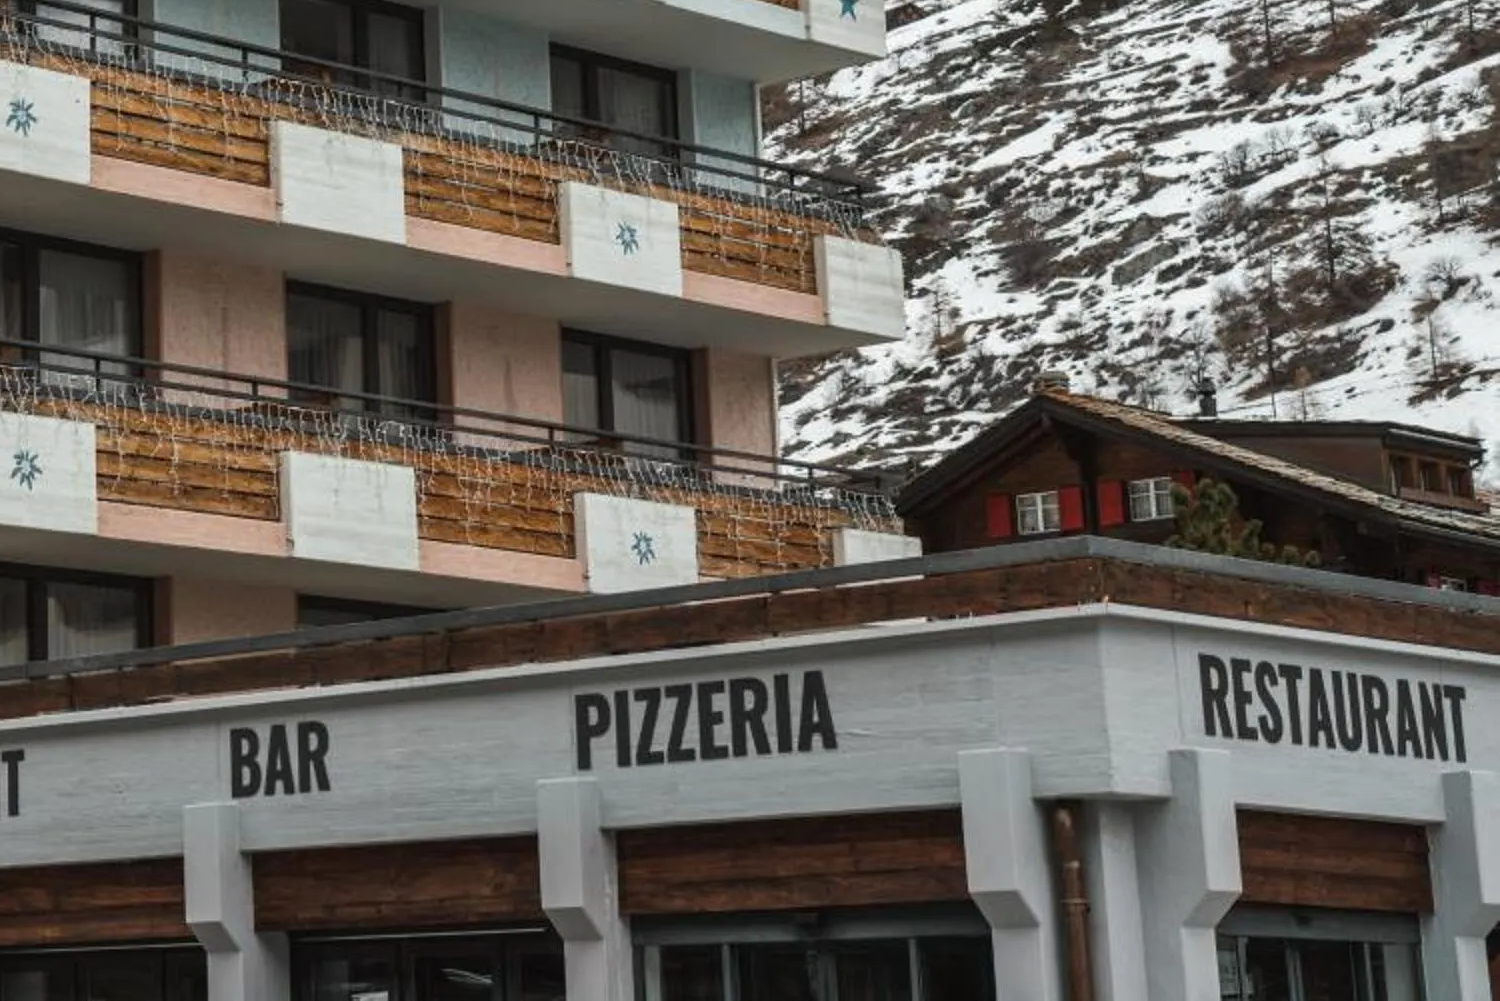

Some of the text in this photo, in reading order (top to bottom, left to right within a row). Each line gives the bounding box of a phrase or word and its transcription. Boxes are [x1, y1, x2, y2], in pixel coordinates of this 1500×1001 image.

[574, 670, 838, 771] PIZZERIA
[1198, 653, 1468, 764] RESTAURANT
[230, 721, 331, 798] BAR
